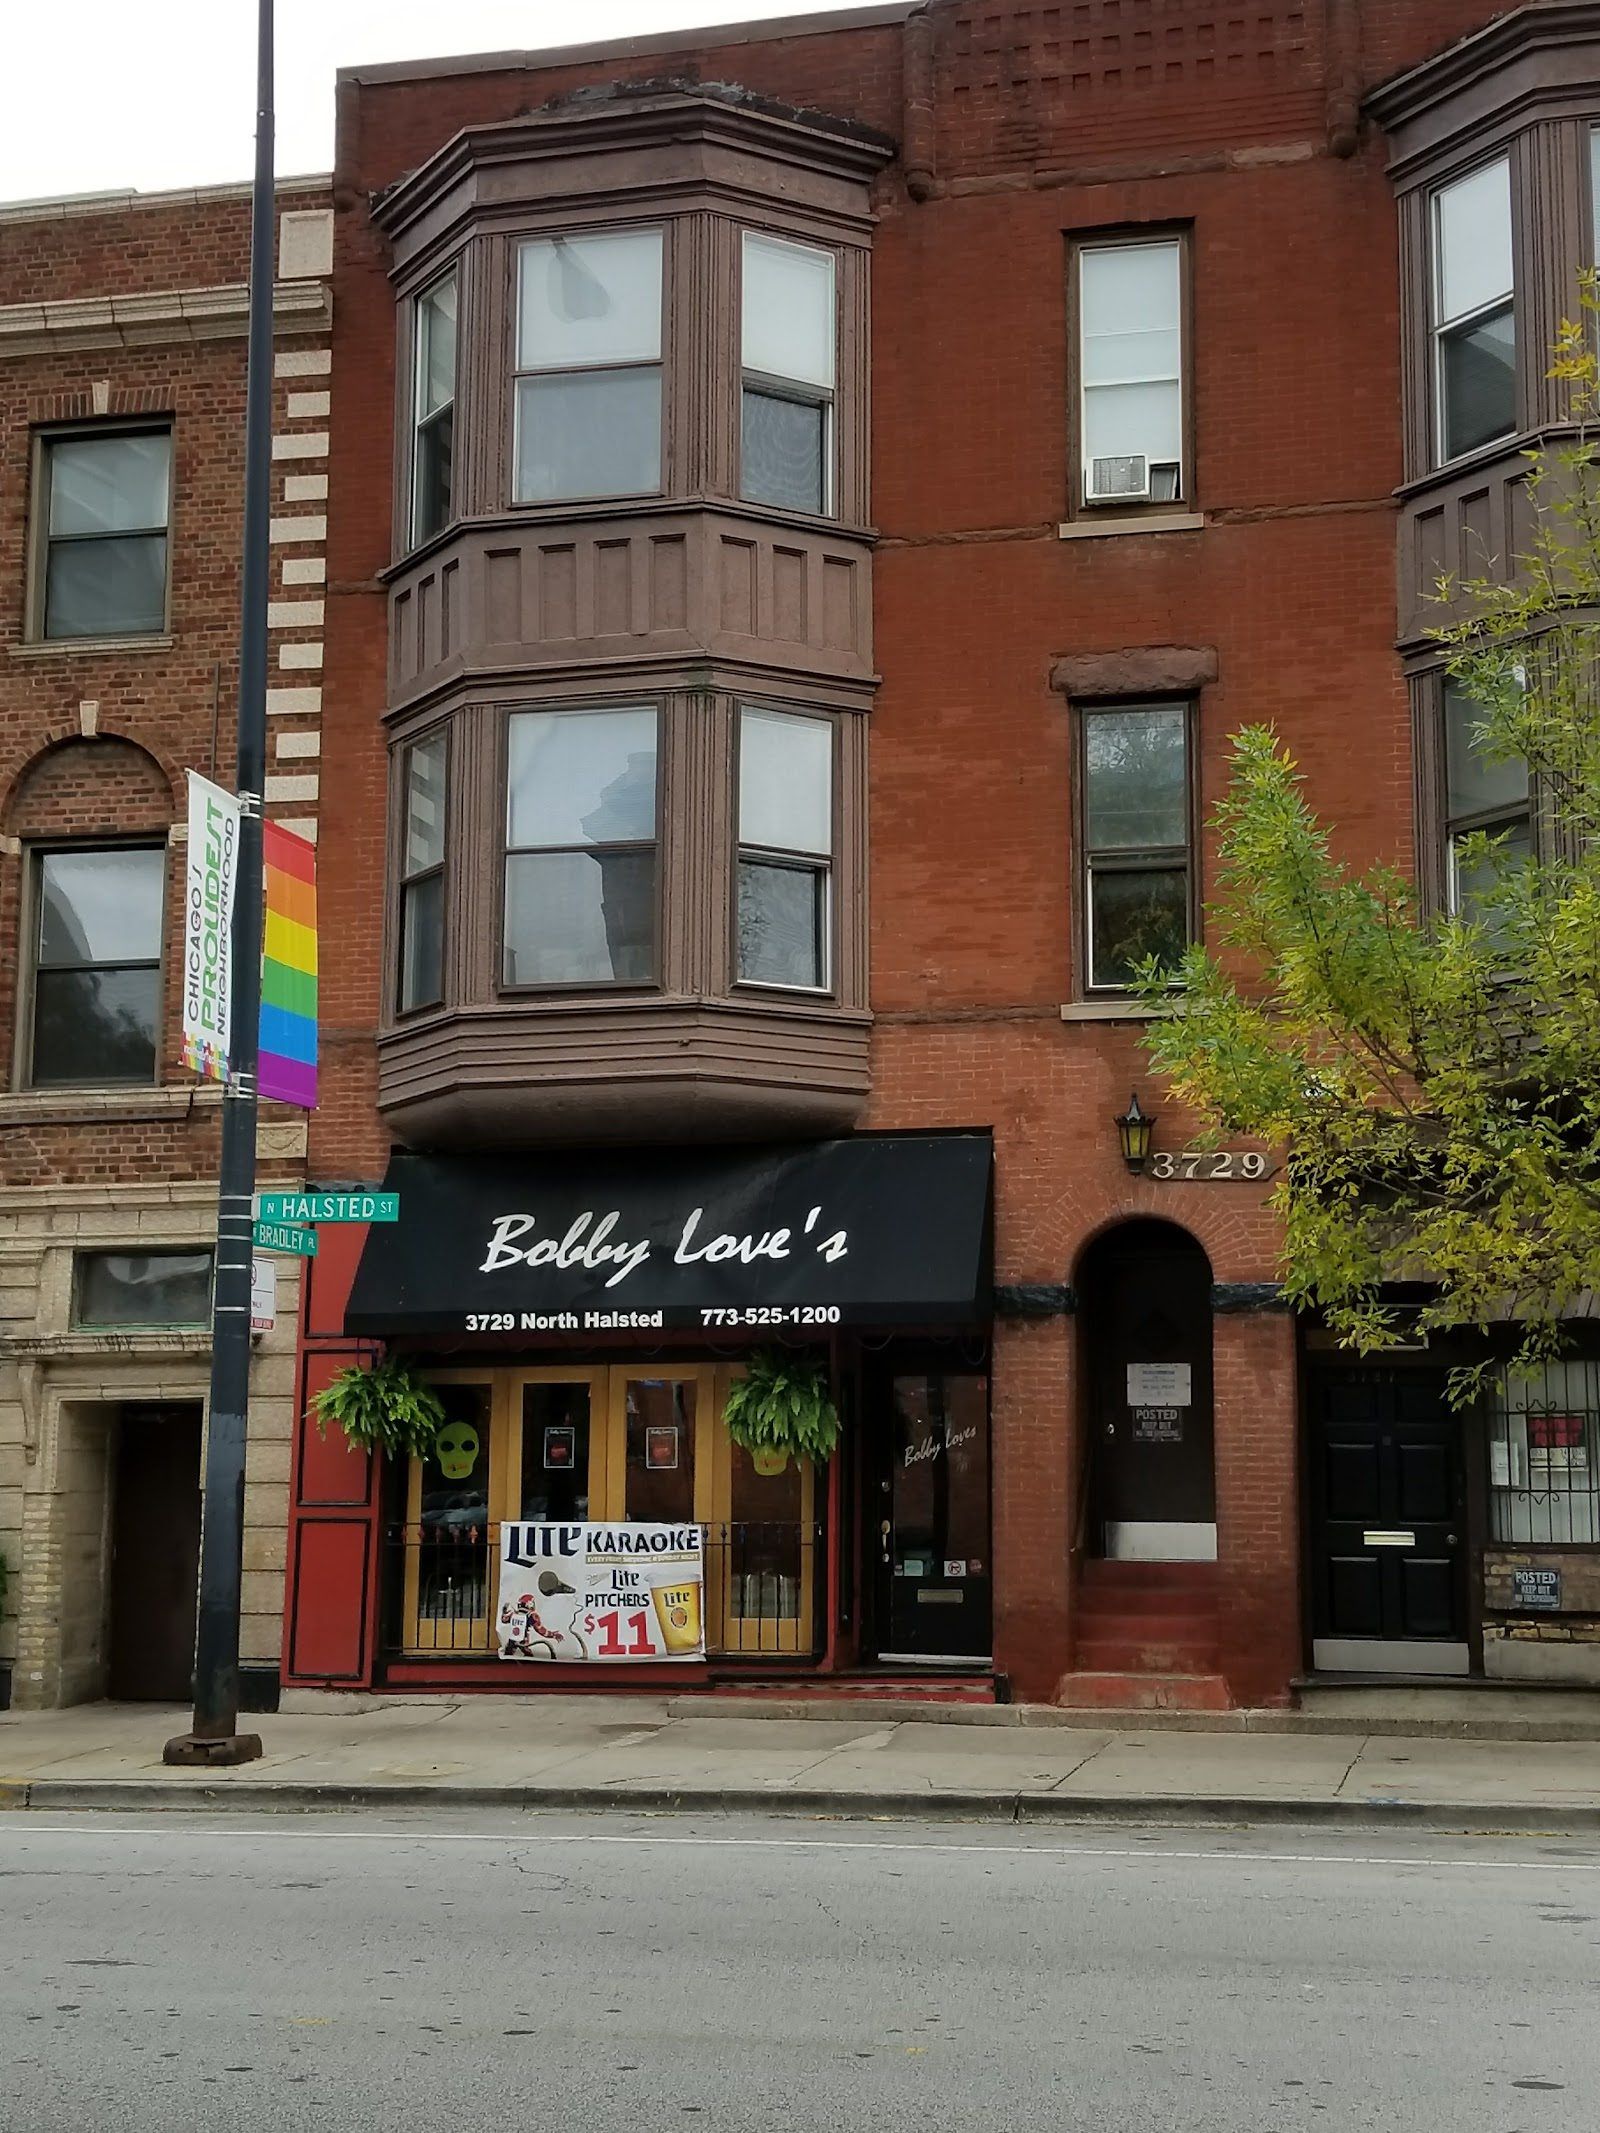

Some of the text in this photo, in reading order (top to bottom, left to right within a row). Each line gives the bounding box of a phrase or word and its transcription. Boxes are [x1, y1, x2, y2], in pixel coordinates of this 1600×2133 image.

[201, 797, 223, 1030] PROUDEST
[217, 818, 234, 1035] NEIGHBORHOOD
[188, 865, 202, 1021] CHICAGO'S
[1152, 1152, 1267, 1179] 3729
[267, 1197, 393, 1218] N HALSTED ST
[259, 1223, 303, 1250] BRADLEY
[307, 1236, 315, 1249] PL
[478, 1205, 848, 1288] Bobby Love's
[465, 1306, 841, 1331] 3729 North Halsted 773-525-1200
[1135, 1409, 1178, 1420] POSTED
[904, 1435, 941, 1468] Bobby
[587, 1528, 700, 1553] KARAOKE
[1515, 1571, 1556, 1585] POSTED
[585, 1593, 650, 1608] PITCHERS
[584, 1610, 656, 1656] $11
